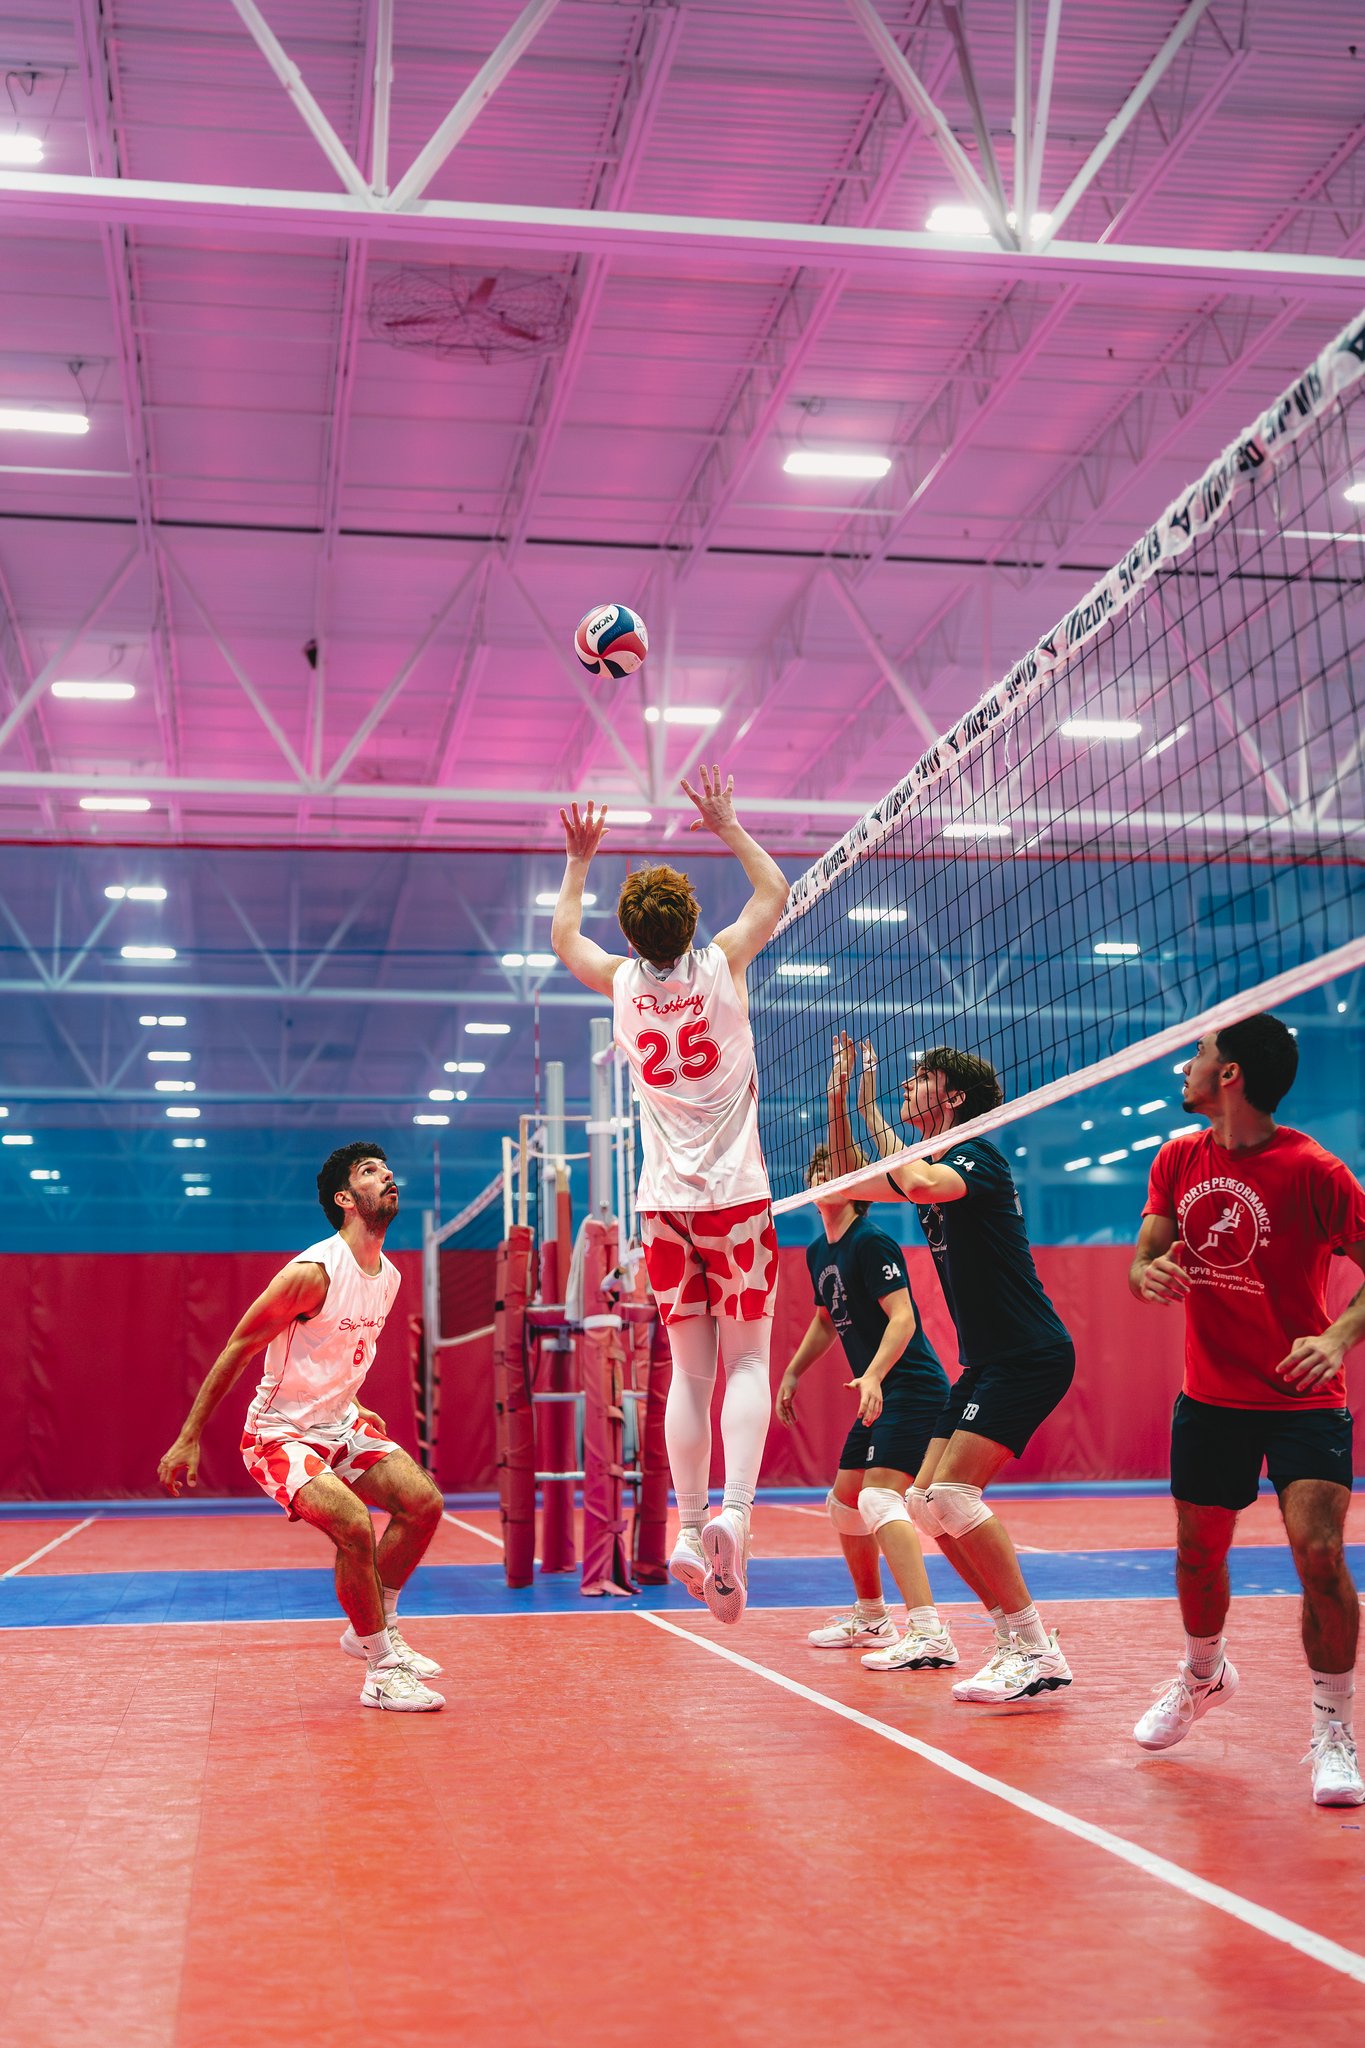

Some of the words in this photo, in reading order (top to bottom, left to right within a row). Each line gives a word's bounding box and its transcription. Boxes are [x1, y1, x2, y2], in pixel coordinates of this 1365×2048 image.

[589, 613, 614, 636] NCAA
[635, 1016, 721, 1089] 25
[952, 1155, 976, 1172] 34
[1177, 1180, 1211, 1216] SPORTS
[1211, 1177, 1272, 1233] PERFORMANCE
[881, 1262, 902, 1281] 34
[1189, 1266, 1211, 1276] SPVB
[1212, 1270, 1243, 1282] Summer
[1244, 1277, 1265, 1290] Camp
